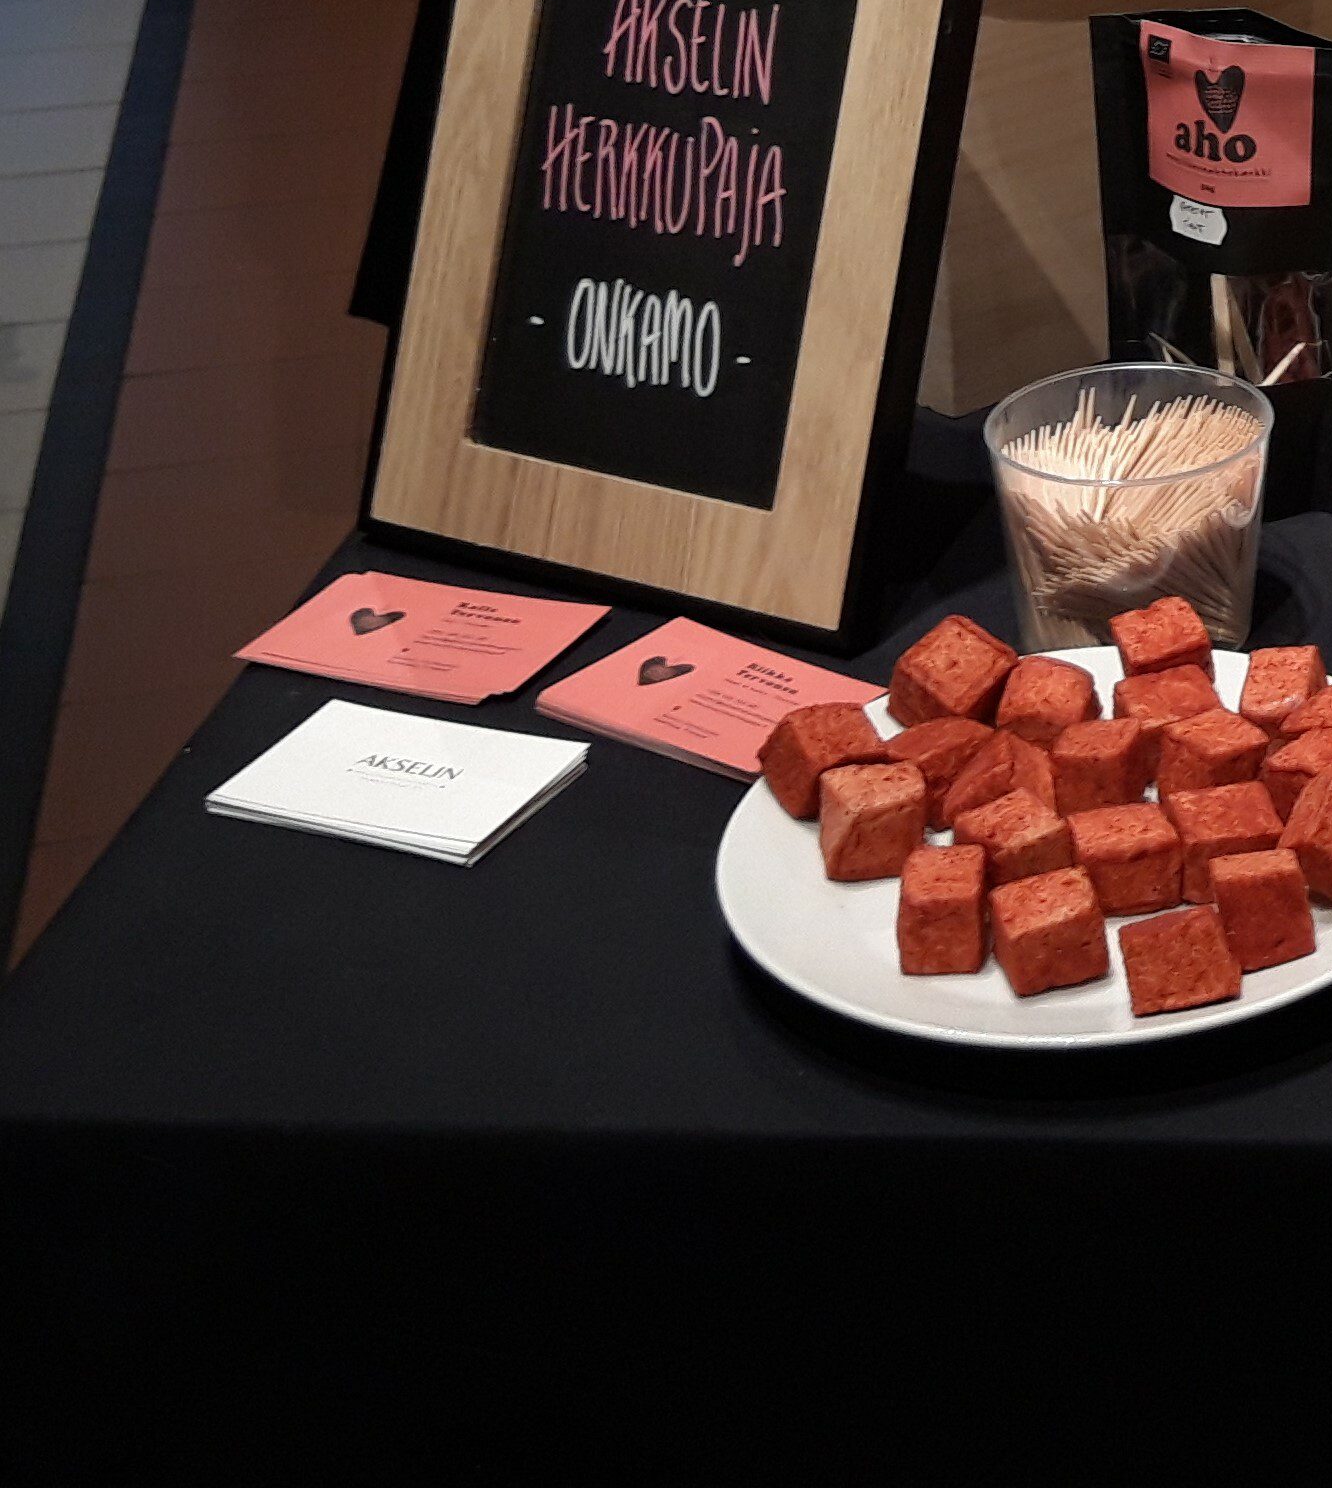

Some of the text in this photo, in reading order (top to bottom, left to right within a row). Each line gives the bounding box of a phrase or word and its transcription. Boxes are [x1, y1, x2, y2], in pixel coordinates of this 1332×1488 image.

[1174, 119, 1257, 164] aho
[541, 102, 788, 268] HERKKUPAJA
[353, 754, 464, 780] AKSELIN
